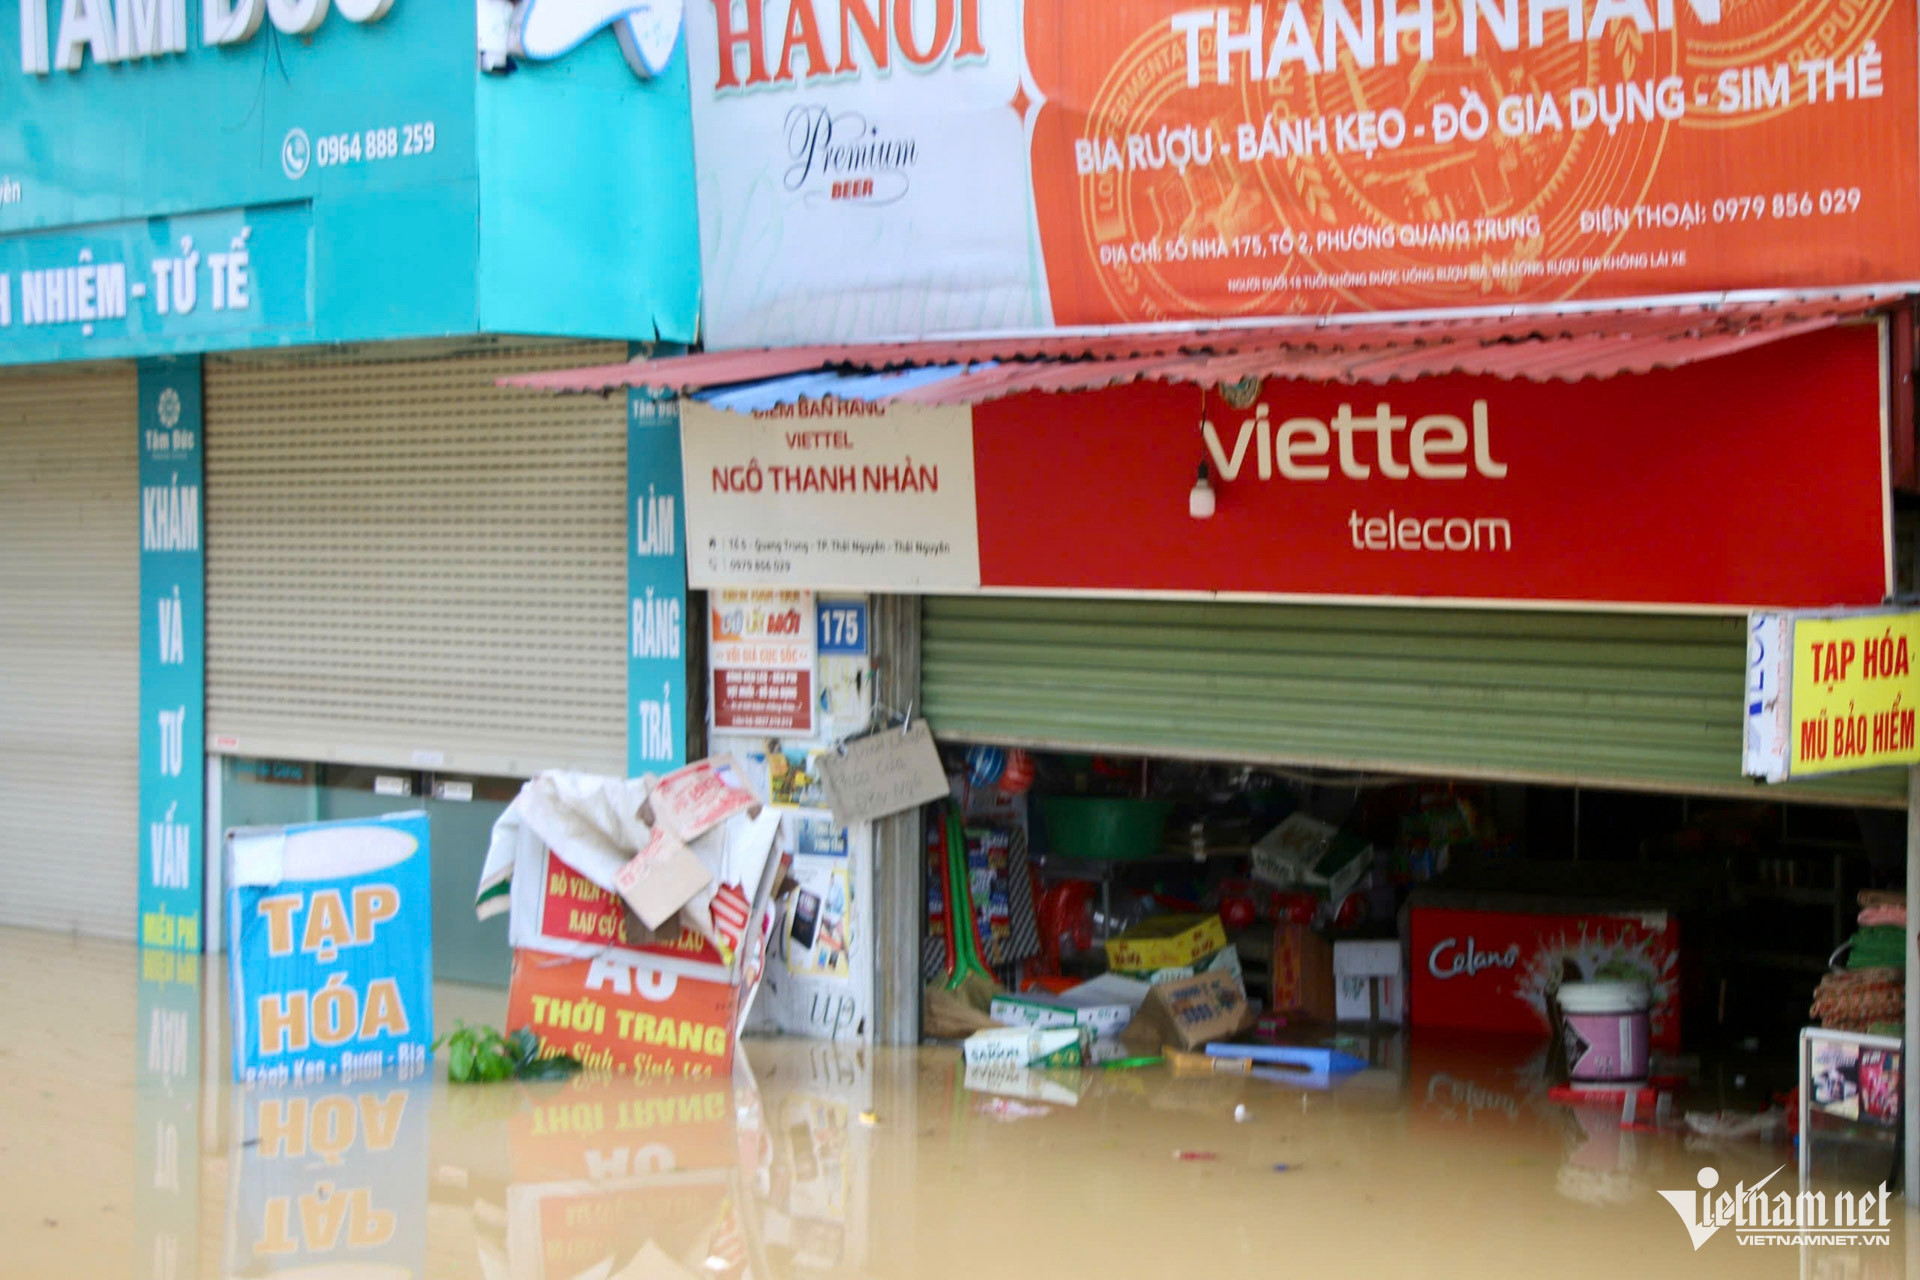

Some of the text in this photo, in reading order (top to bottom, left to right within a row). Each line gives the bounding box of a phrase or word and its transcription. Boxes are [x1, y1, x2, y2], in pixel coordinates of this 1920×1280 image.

[1171, 0, 1434, 87] THANH
[1075, 135, 1124, 175] BIA
[1128, 123, 1212, 176] RƯỢU
[1238, 112, 1326, 162] BÁNH
[1335, 107, 1404, 160] KẸO
[1432, 87, 1489, 143] ĐỒ
[1498, 90, 1563, 138] GIA
[1571, 77, 1684, 136] DỤNG
[1718, 63, 1790, 114] SIM
[1798, 39, 1883, 103] THẺ
[317, 122, 435, 168] 0964 888 259
[784, 104, 919, 191] Premium
[832, 178, 873, 201] BEER
[1581, 187, 1861, 236] ĐIỆN THOẠI: 0979 856 029
[1166, 233, 1188, 261] SỐ
[1233, 232, 1266, 258] 175,
[1317, 224, 1395, 252] PHƯỜNG
[1400, 220, 1469, 247] QUANG
[1474, 213, 1541, 241] TRUNG
[1672, 250, 1686, 266] XE
[22, 247, 126, 336] NHIỆM
[152, 234, 199, 315] TỬ
[208, 226, 252, 310] TẾ
[785, 431, 853, 450] VIETTEL
[1200, 399, 1508, 481] viettel
[712, 457, 763, 493] NGÔ
[769, 466, 856, 493] THANH
[143, 471, 198, 552] KHÁM
[637, 483, 675, 556] LÀM
[1348, 509, 1511, 551] telecom
[632, 586, 680, 659] RĂNG
[767, 607, 801, 635] MỚI
[821, 609, 859, 646] 175
[1811, 640, 1855, 693] TẠP
[1863, 626, 1909, 681] HÓA
[158, 704, 185, 777] TƯ
[1801, 690, 1915, 763] MŨ BẢO HIỂM
[257, 885, 400, 962] TẠP
[569, 909, 596, 937] RAU
[1428, 935, 1520, 980] Celano
[258, 972, 409, 1056] HÓA
[531, 994, 728, 1056] THỜI TRANG
